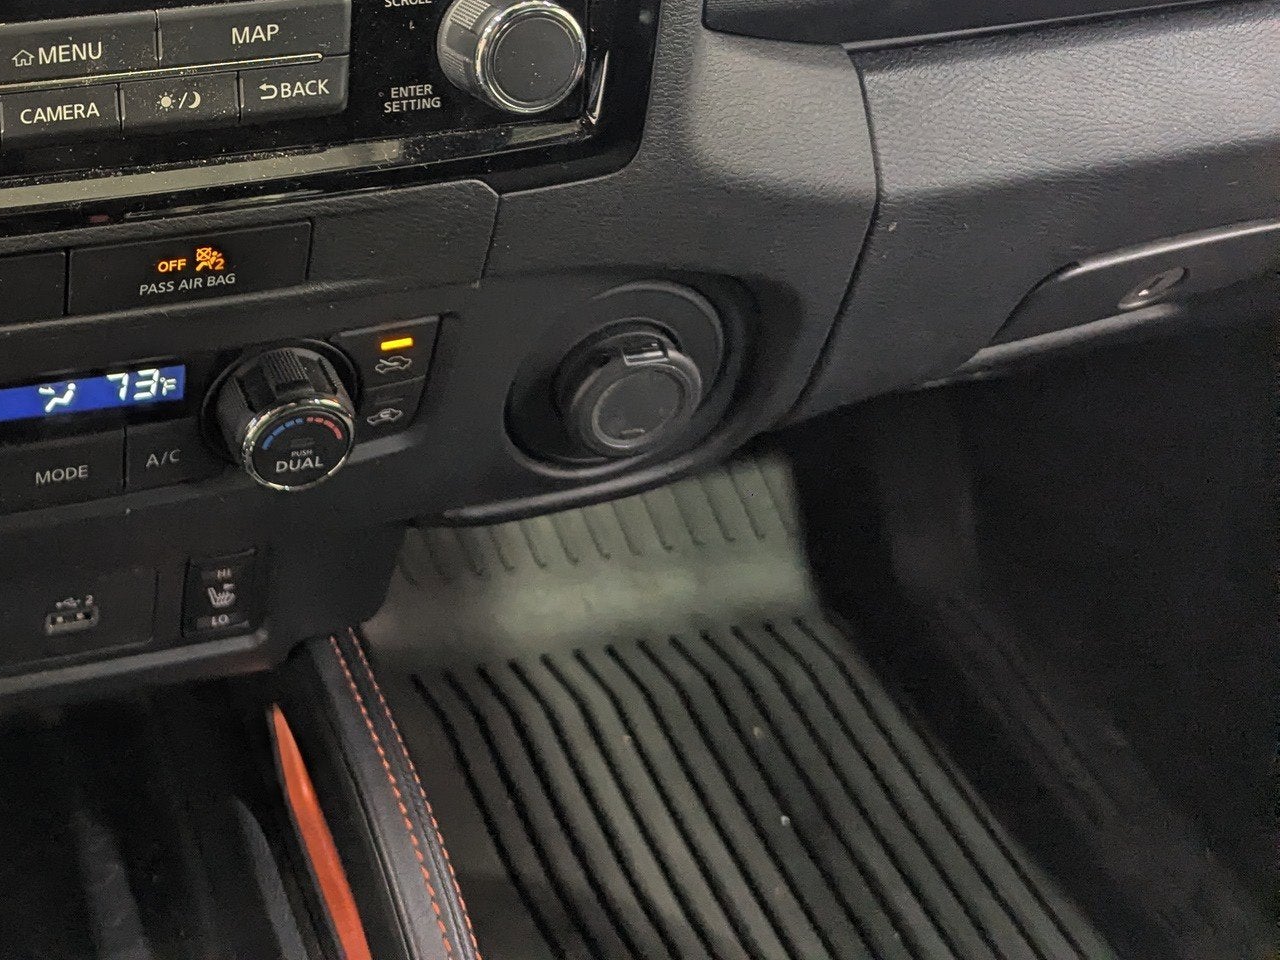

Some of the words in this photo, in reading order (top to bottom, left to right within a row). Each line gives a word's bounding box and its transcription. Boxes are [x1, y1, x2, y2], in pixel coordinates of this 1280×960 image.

[230, 23, 280, 46] MAP
[37, 41, 103, 66] MENU
[280, 78, 330, 100] BACK
[390, 83, 434, 99] ENTER
[19, 101, 101, 126] CAMERA
[384, 96, 442, 114] SETTING
[157, 258, 187, 273] OFF
[138, 281, 175, 296] PASS
[177, 276, 203, 291] AIR
[206, 272, 237, 287] BAG
[145, 448, 183, 468] A/C
[290, 449, 314, 457] PUSH
[34, 464, 90, 486] MODE
[275, 455, 325, 474] DUAL
